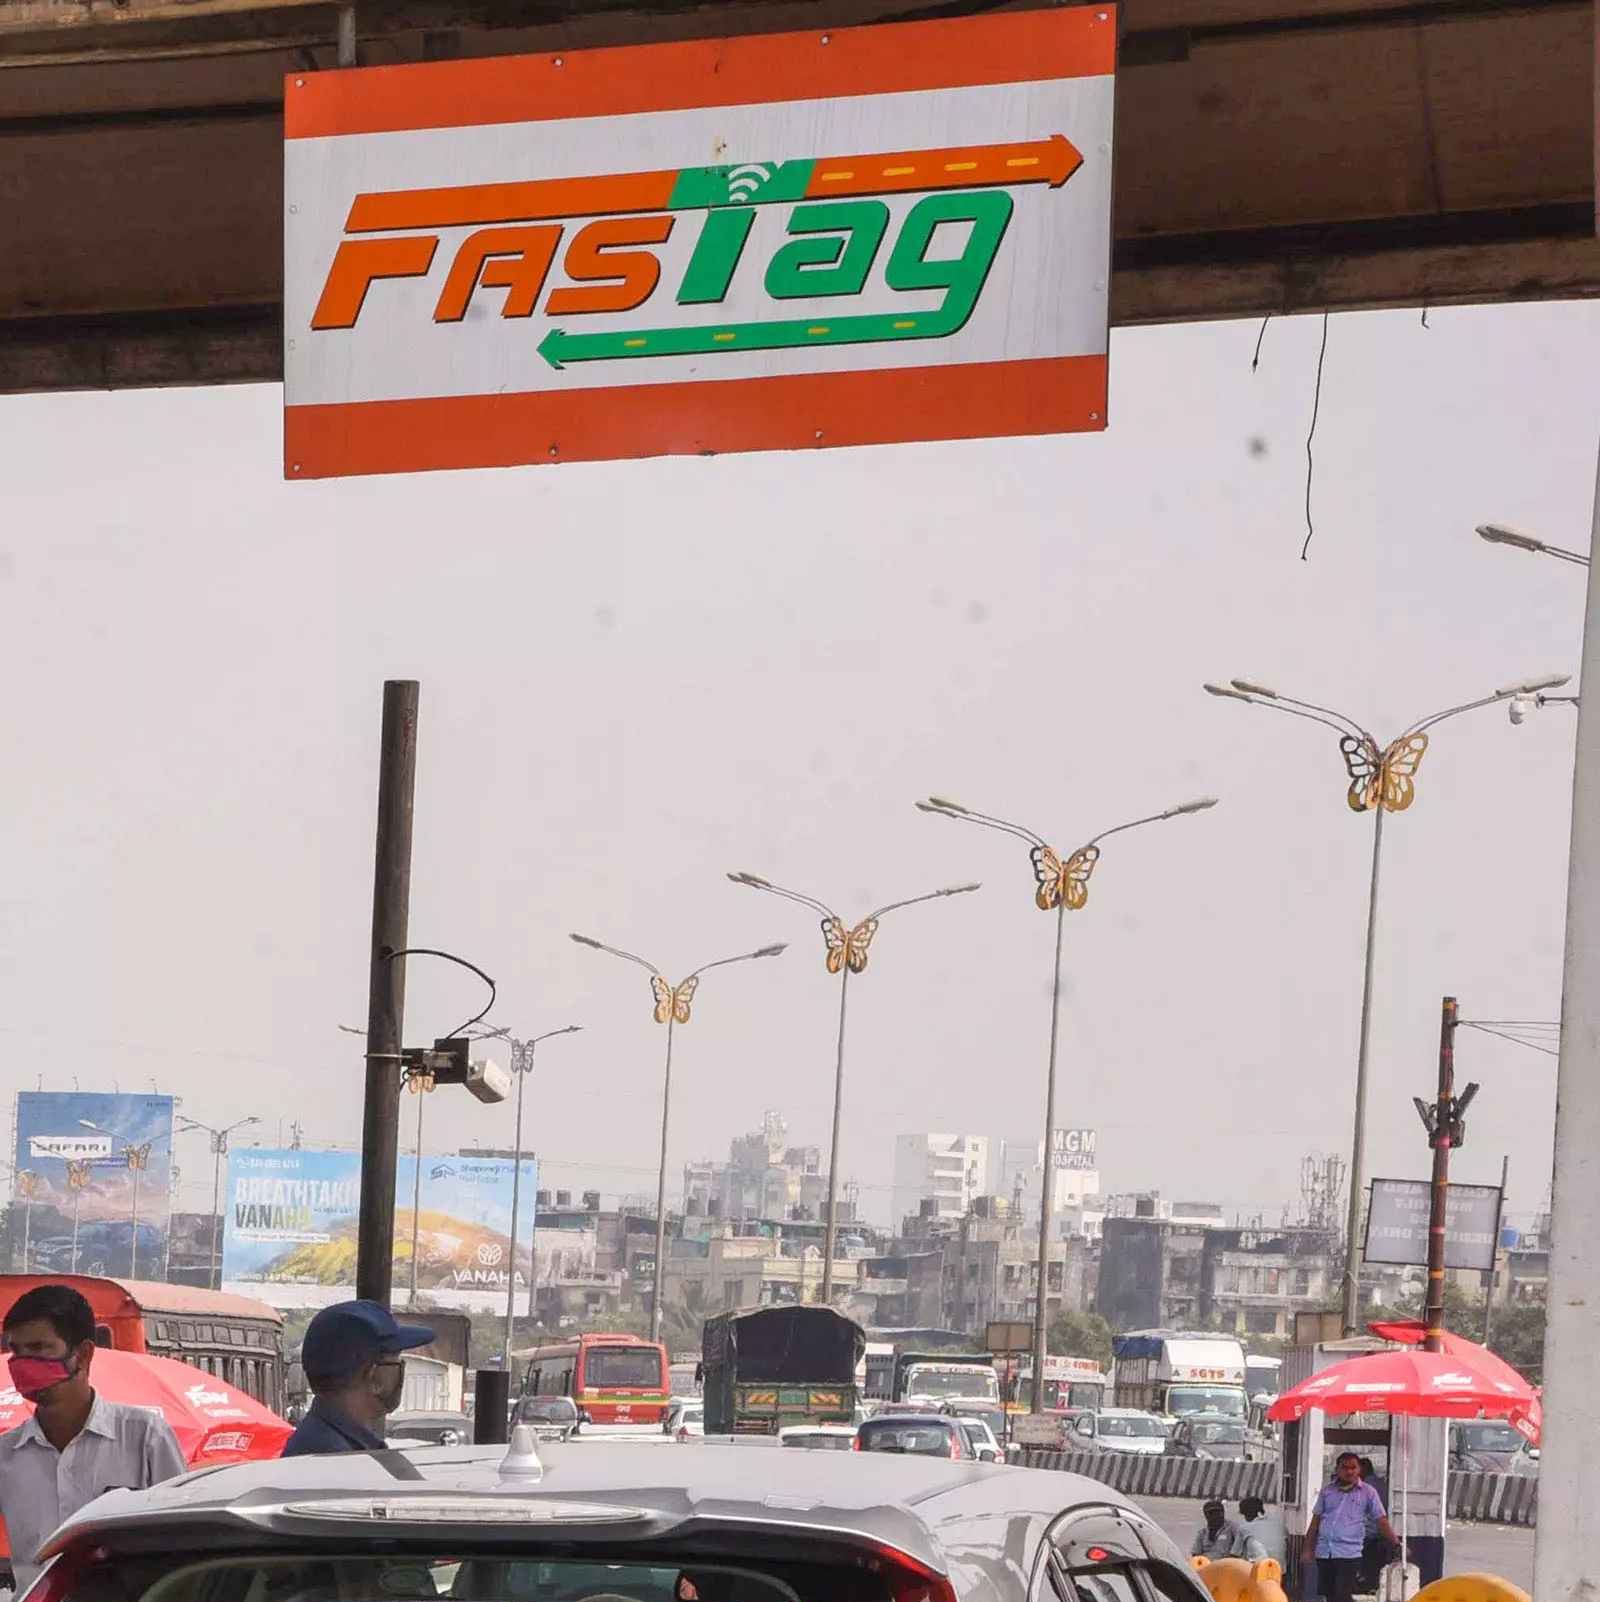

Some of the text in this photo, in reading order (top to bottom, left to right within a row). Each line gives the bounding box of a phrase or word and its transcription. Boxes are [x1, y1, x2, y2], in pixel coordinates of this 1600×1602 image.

[311, 160, 1014, 369] FASTag
[1052, 1130, 1096, 1152] MGM
[235, 1177, 360, 1207] BREATHTAKI
[235, 1203, 311, 1231] VANAHA
[452, 1269, 526, 1285] VANAHA
[1189, 1368, 1226, 1380] SGTS
